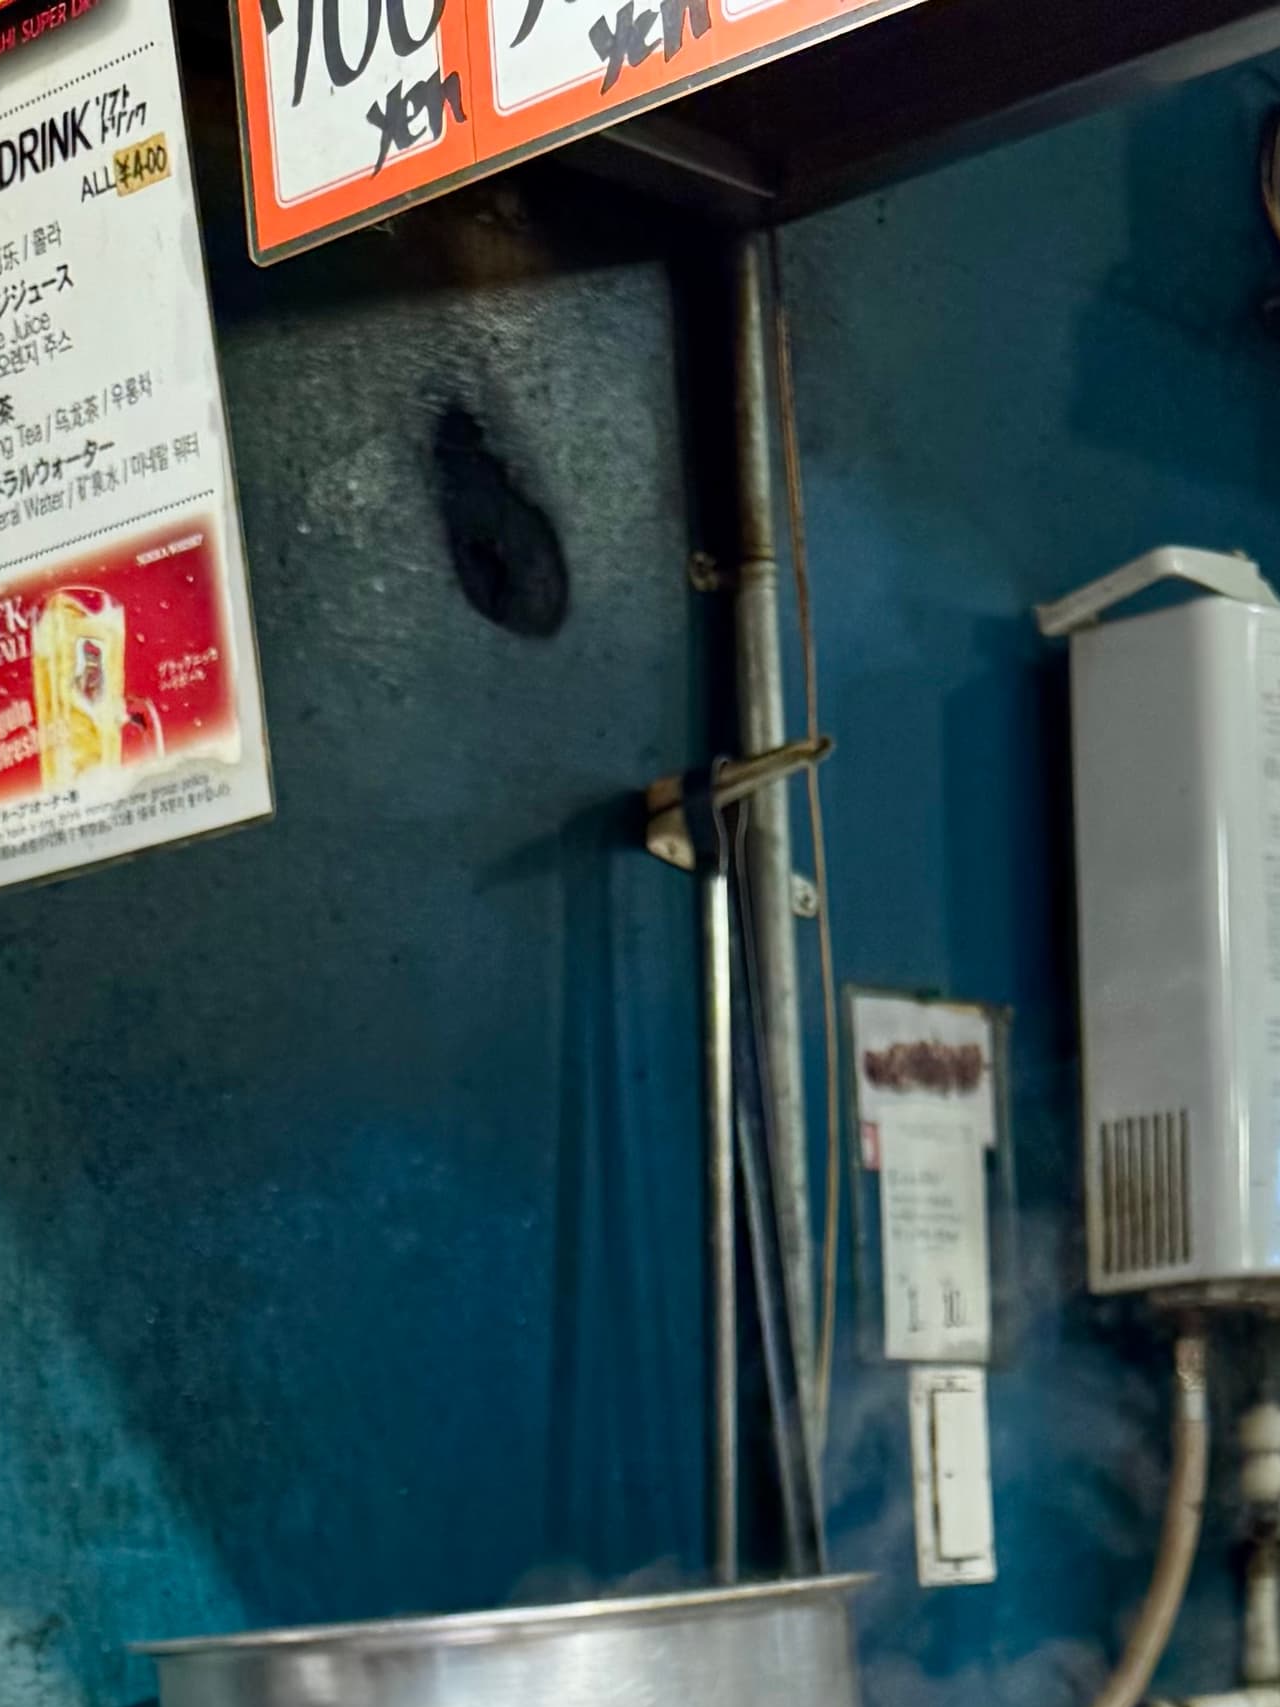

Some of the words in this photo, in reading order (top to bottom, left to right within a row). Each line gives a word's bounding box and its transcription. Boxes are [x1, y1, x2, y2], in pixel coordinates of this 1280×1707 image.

[366, 70, 467, 178] yen
[10, 311, 52, 346] Juice
[16, 420, 43, 449] Tea
[24, 488, 66, 526] Water
